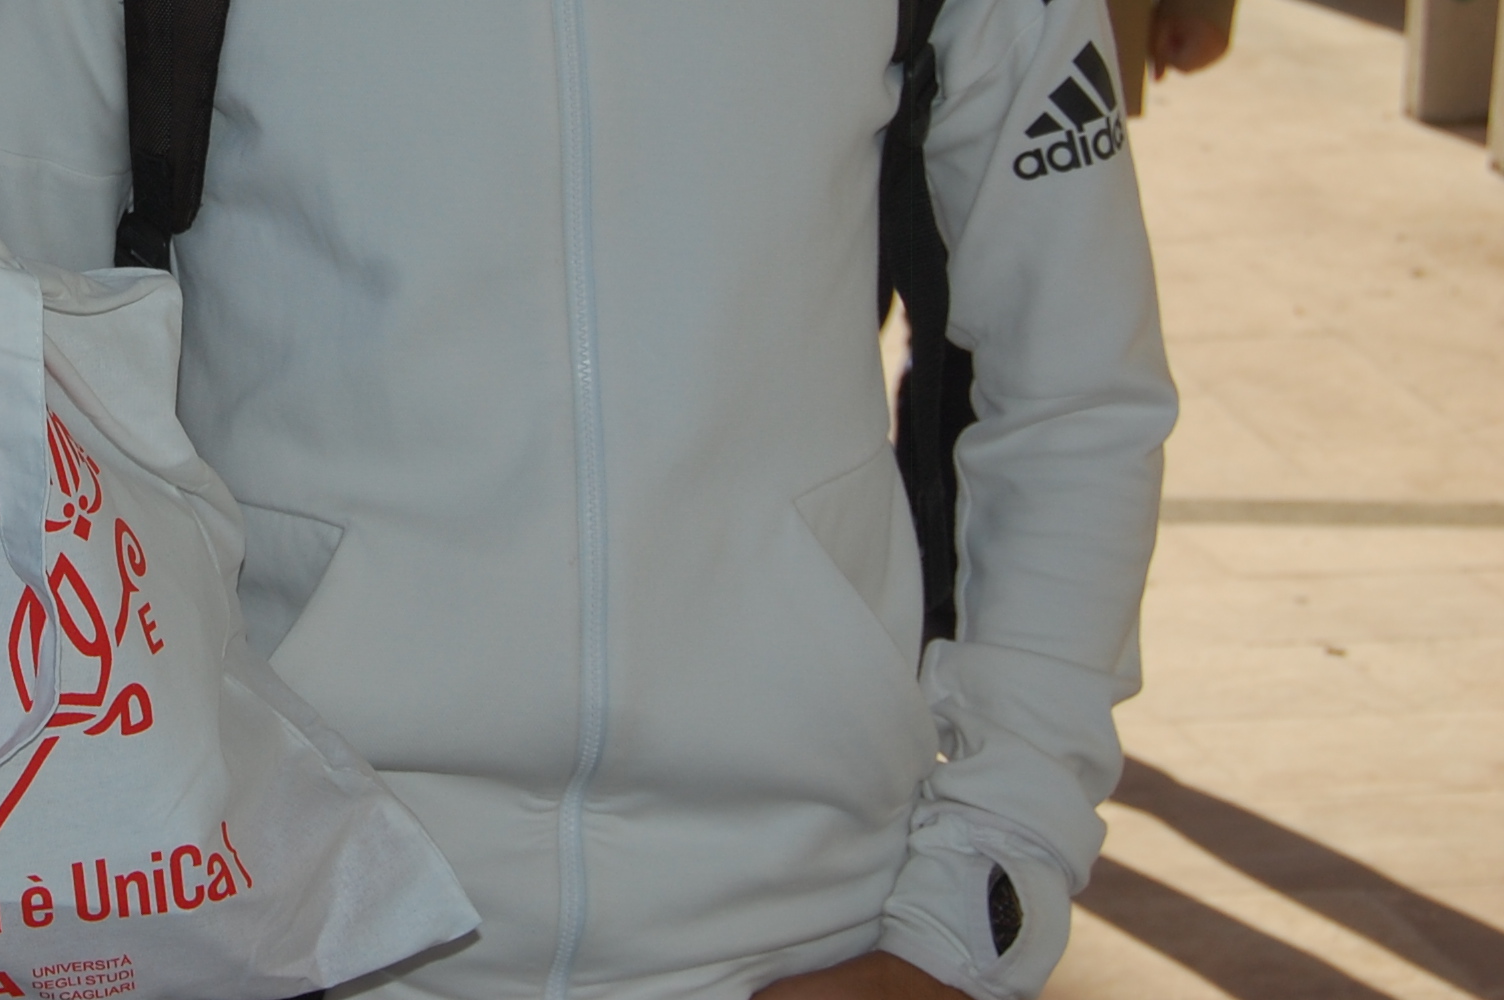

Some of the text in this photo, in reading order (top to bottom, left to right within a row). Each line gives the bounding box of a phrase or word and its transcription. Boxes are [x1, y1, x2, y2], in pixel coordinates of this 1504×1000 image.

[1013, 113, 1125, 181] adida
[21, 874, 55, 928] è
[32, 953, 132, 979] UNIVERSITÀ
[31, 969, 134, 990] DEGLI STUDI
[59, 981, 136, 1000] CAGLIARI
